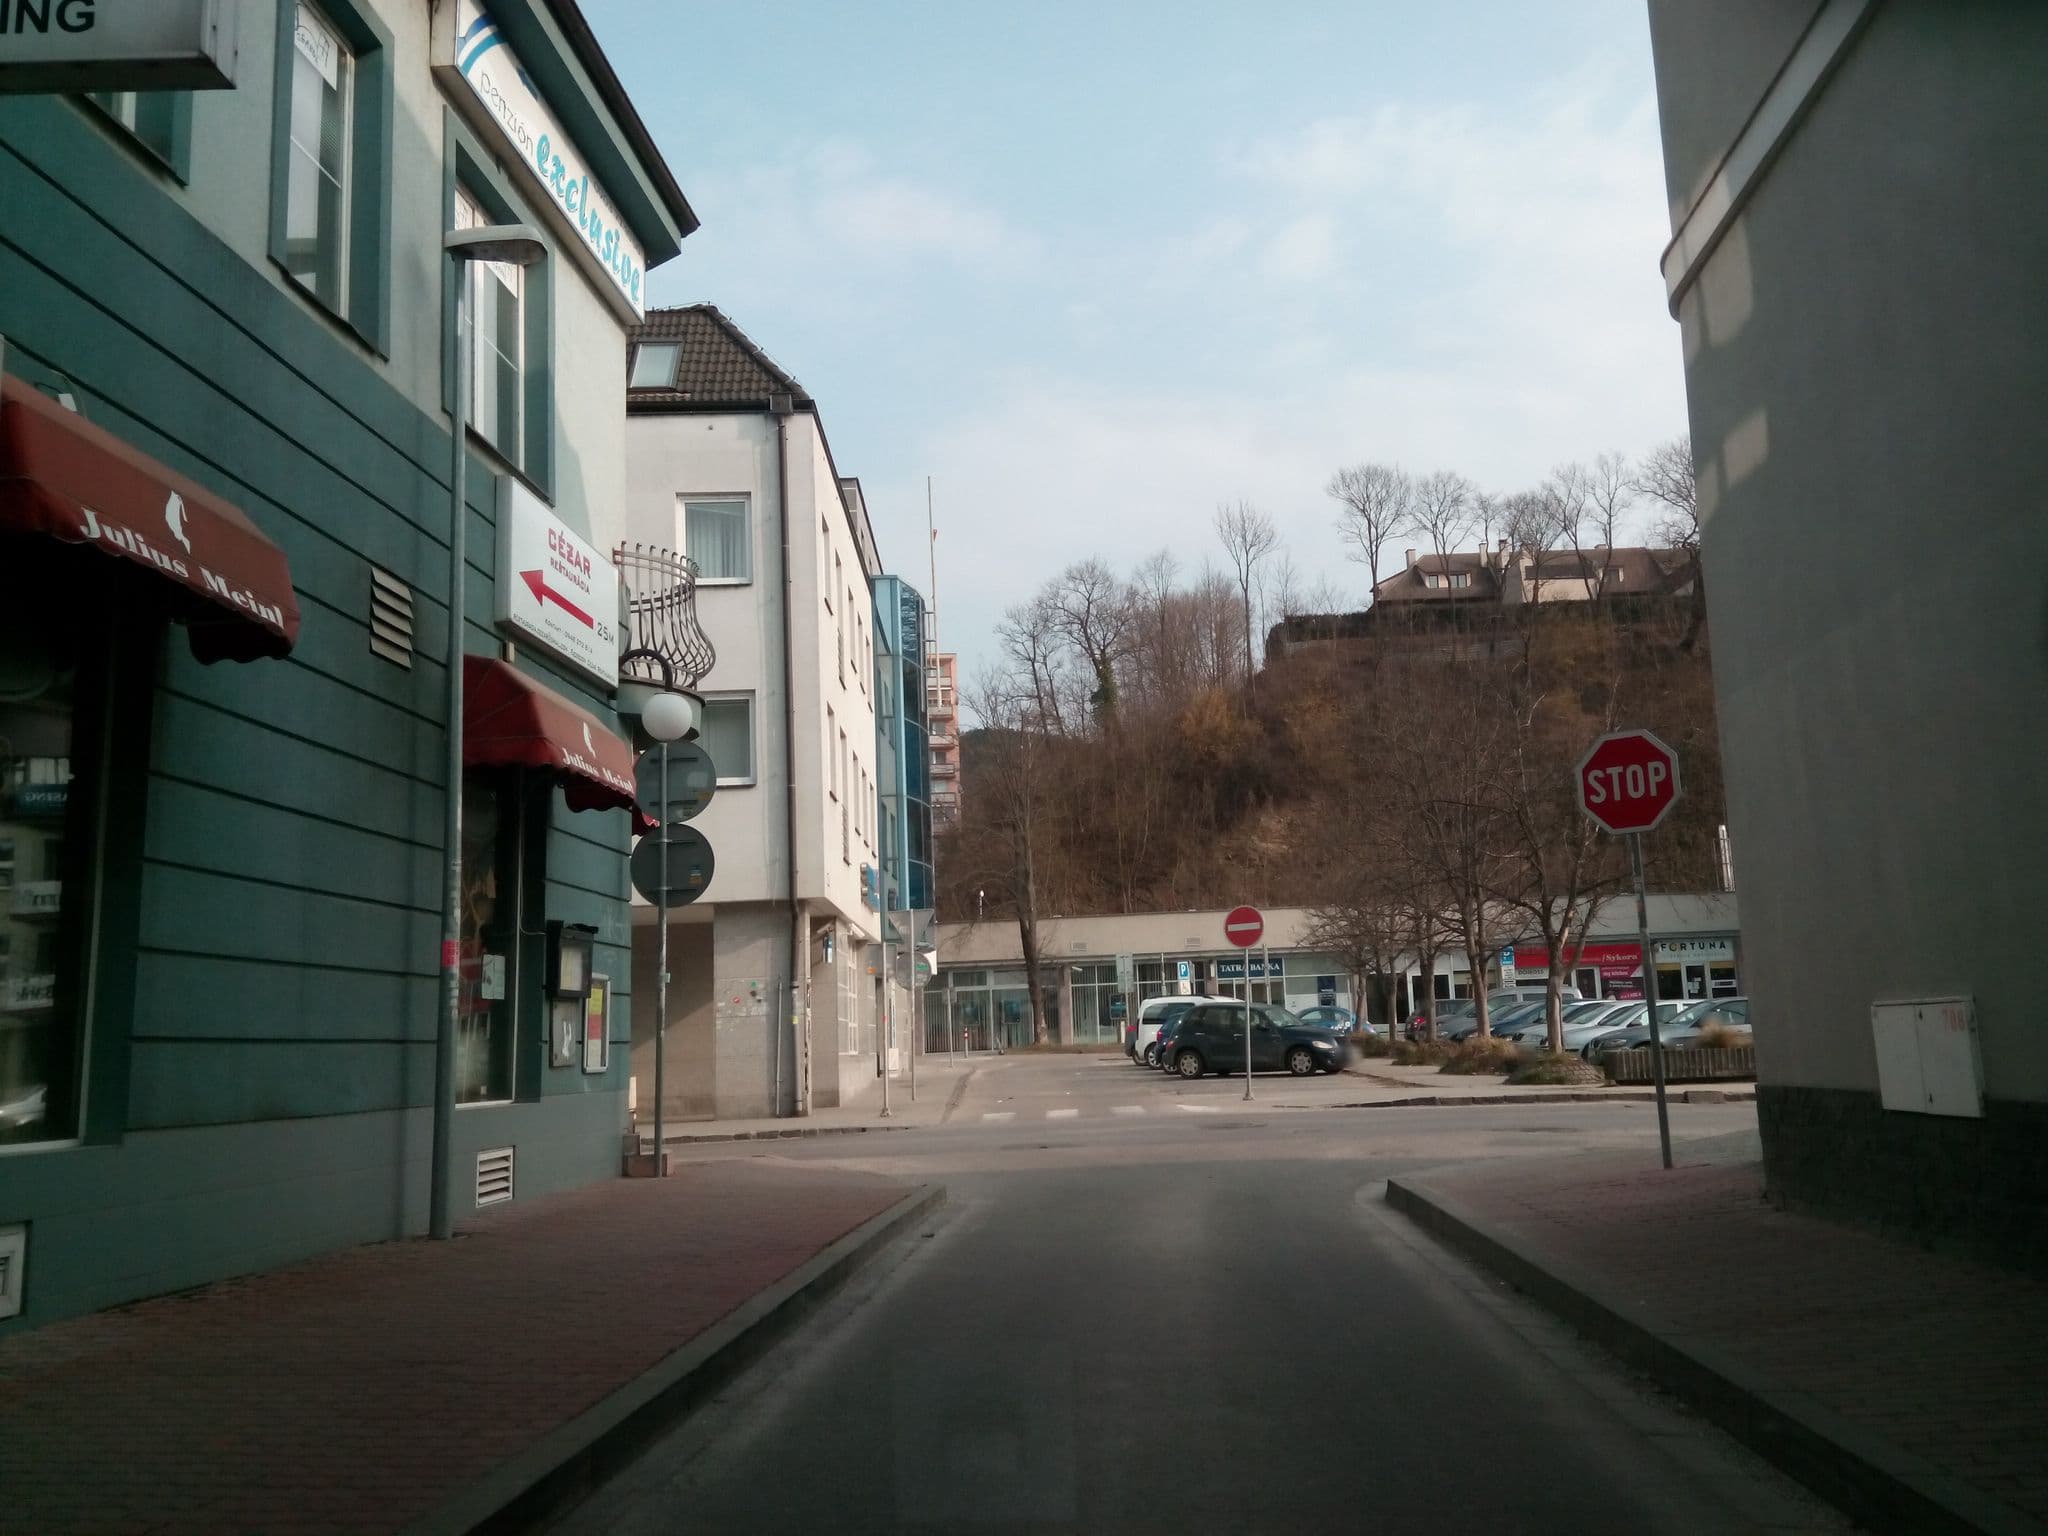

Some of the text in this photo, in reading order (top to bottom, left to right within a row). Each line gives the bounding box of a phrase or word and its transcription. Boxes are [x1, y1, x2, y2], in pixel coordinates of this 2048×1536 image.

[0, 0, 95, 34] ING
[480, 70, 641, 302] penzión exclusive
[79, 506, 285, 630] Julius Meinl
[548, 527, 591, 579] CÉZAR
[561, 747, 600, 777] Julius
[1587, 761, 1667, 803] STOP
[1660, 940, 1727, 952] FORTUNA
[1180, 964, 1186, 975] P
